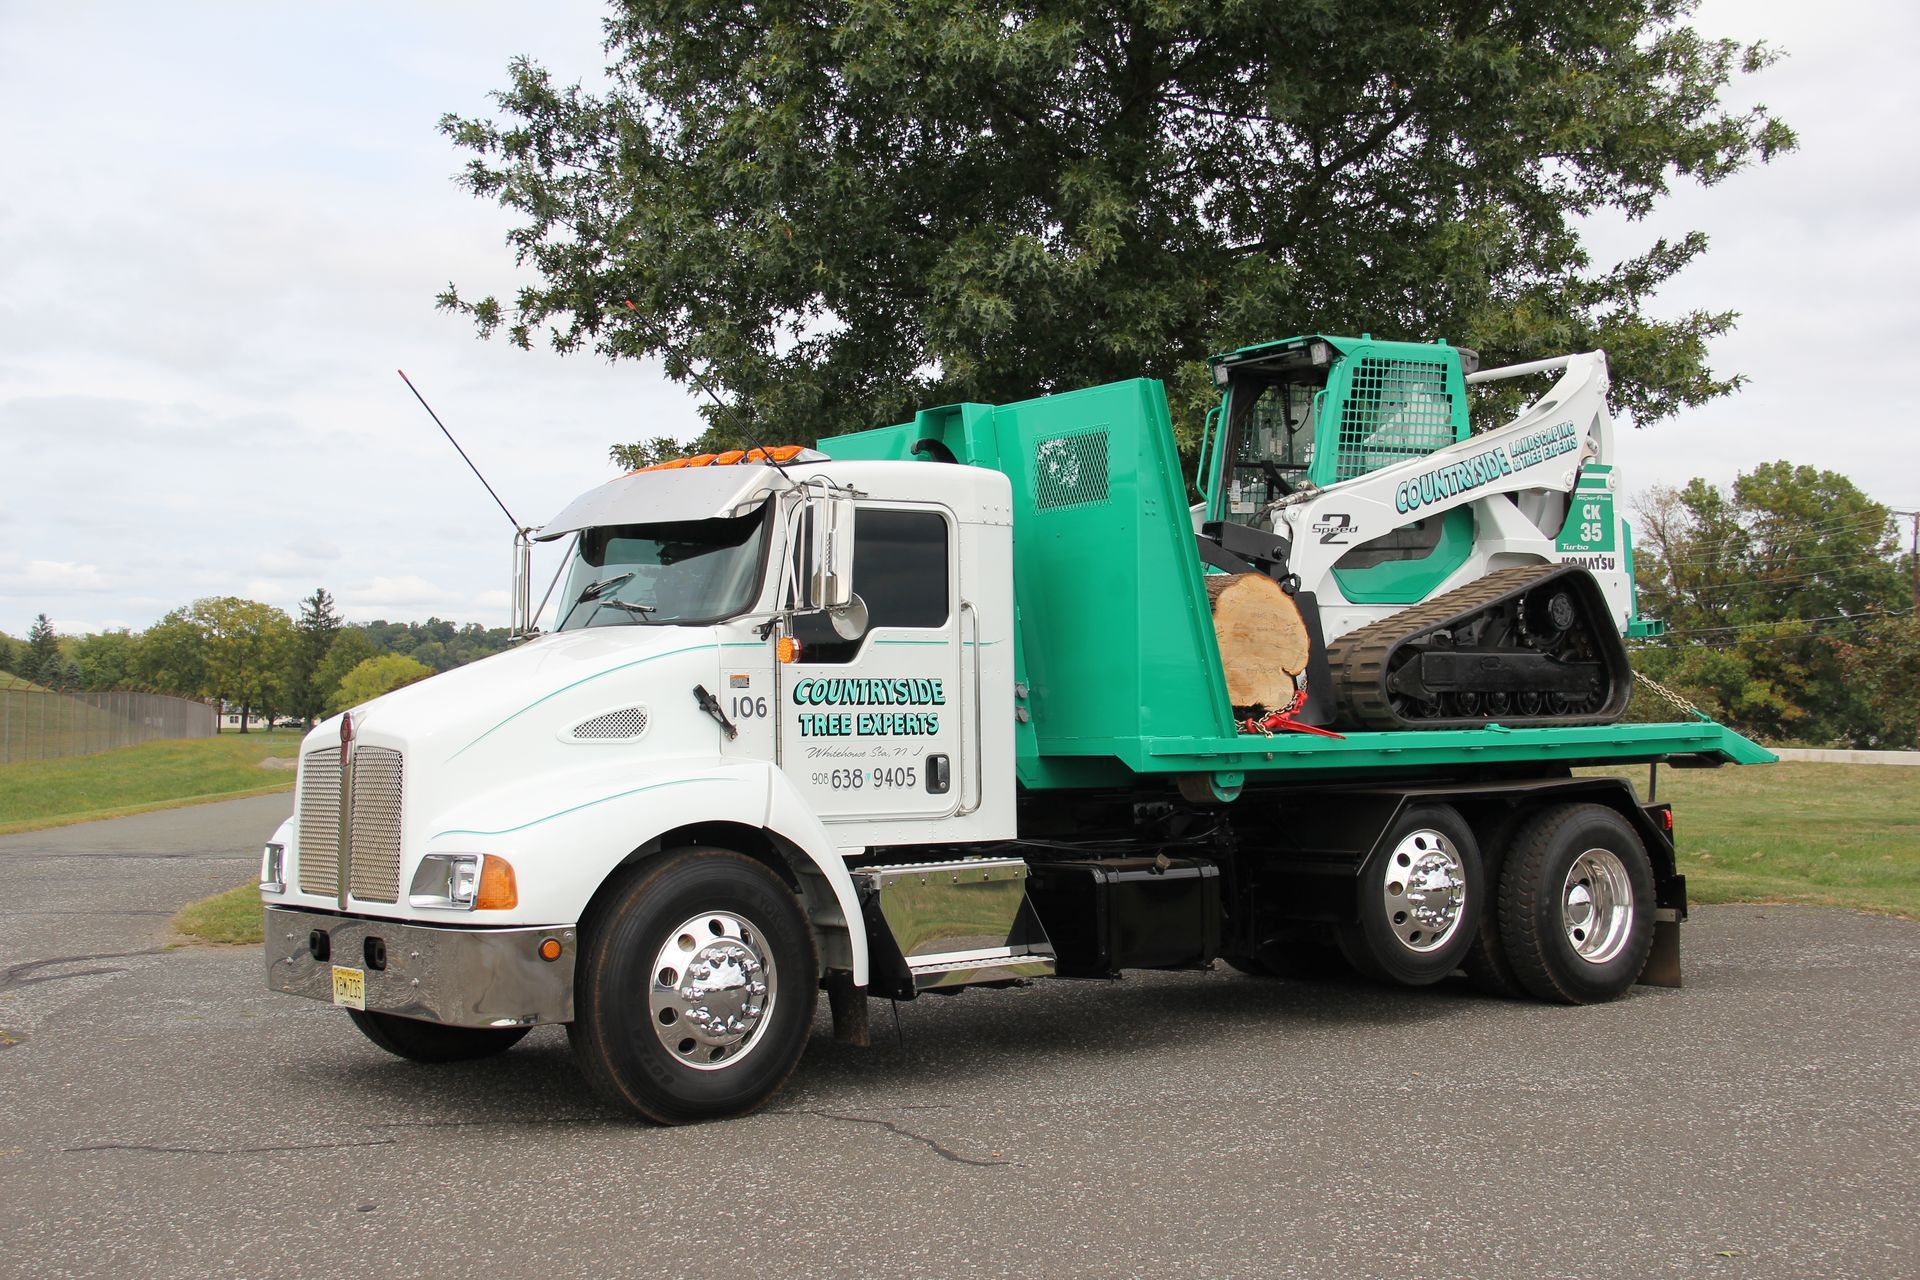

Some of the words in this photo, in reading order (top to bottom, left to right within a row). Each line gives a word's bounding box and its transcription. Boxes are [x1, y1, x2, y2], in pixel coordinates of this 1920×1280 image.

[1509, 420, 1575, 457] LANDSCAPING
[1513, 456, 1522, 472] &
[1520, 449, 1543, 469] TREE
[1542, 435, 1577, 461] EXPERTS
[1395, 447, 1512, 514] COUNTRYSIDE
[1582, 504, 1601, 520] CK
[1312, 523, 1358, 535] Speed
[1580, 522, 1602, 542] 35
[1561, 543, 1589, 551] Turbo
[793, 677, 946, 706] COUNTRYSIDE
[732, 696, 768, 718] 106
[798, 713, 852, 736] TREE
[857, 712, 940, 736] EXPERTS
[805, 746, 867, 759] Whitehouse
[811, 772, 829, 785] 908
[831, 768, 864, 789] 638
[873, 767, 917, 788] 9405
